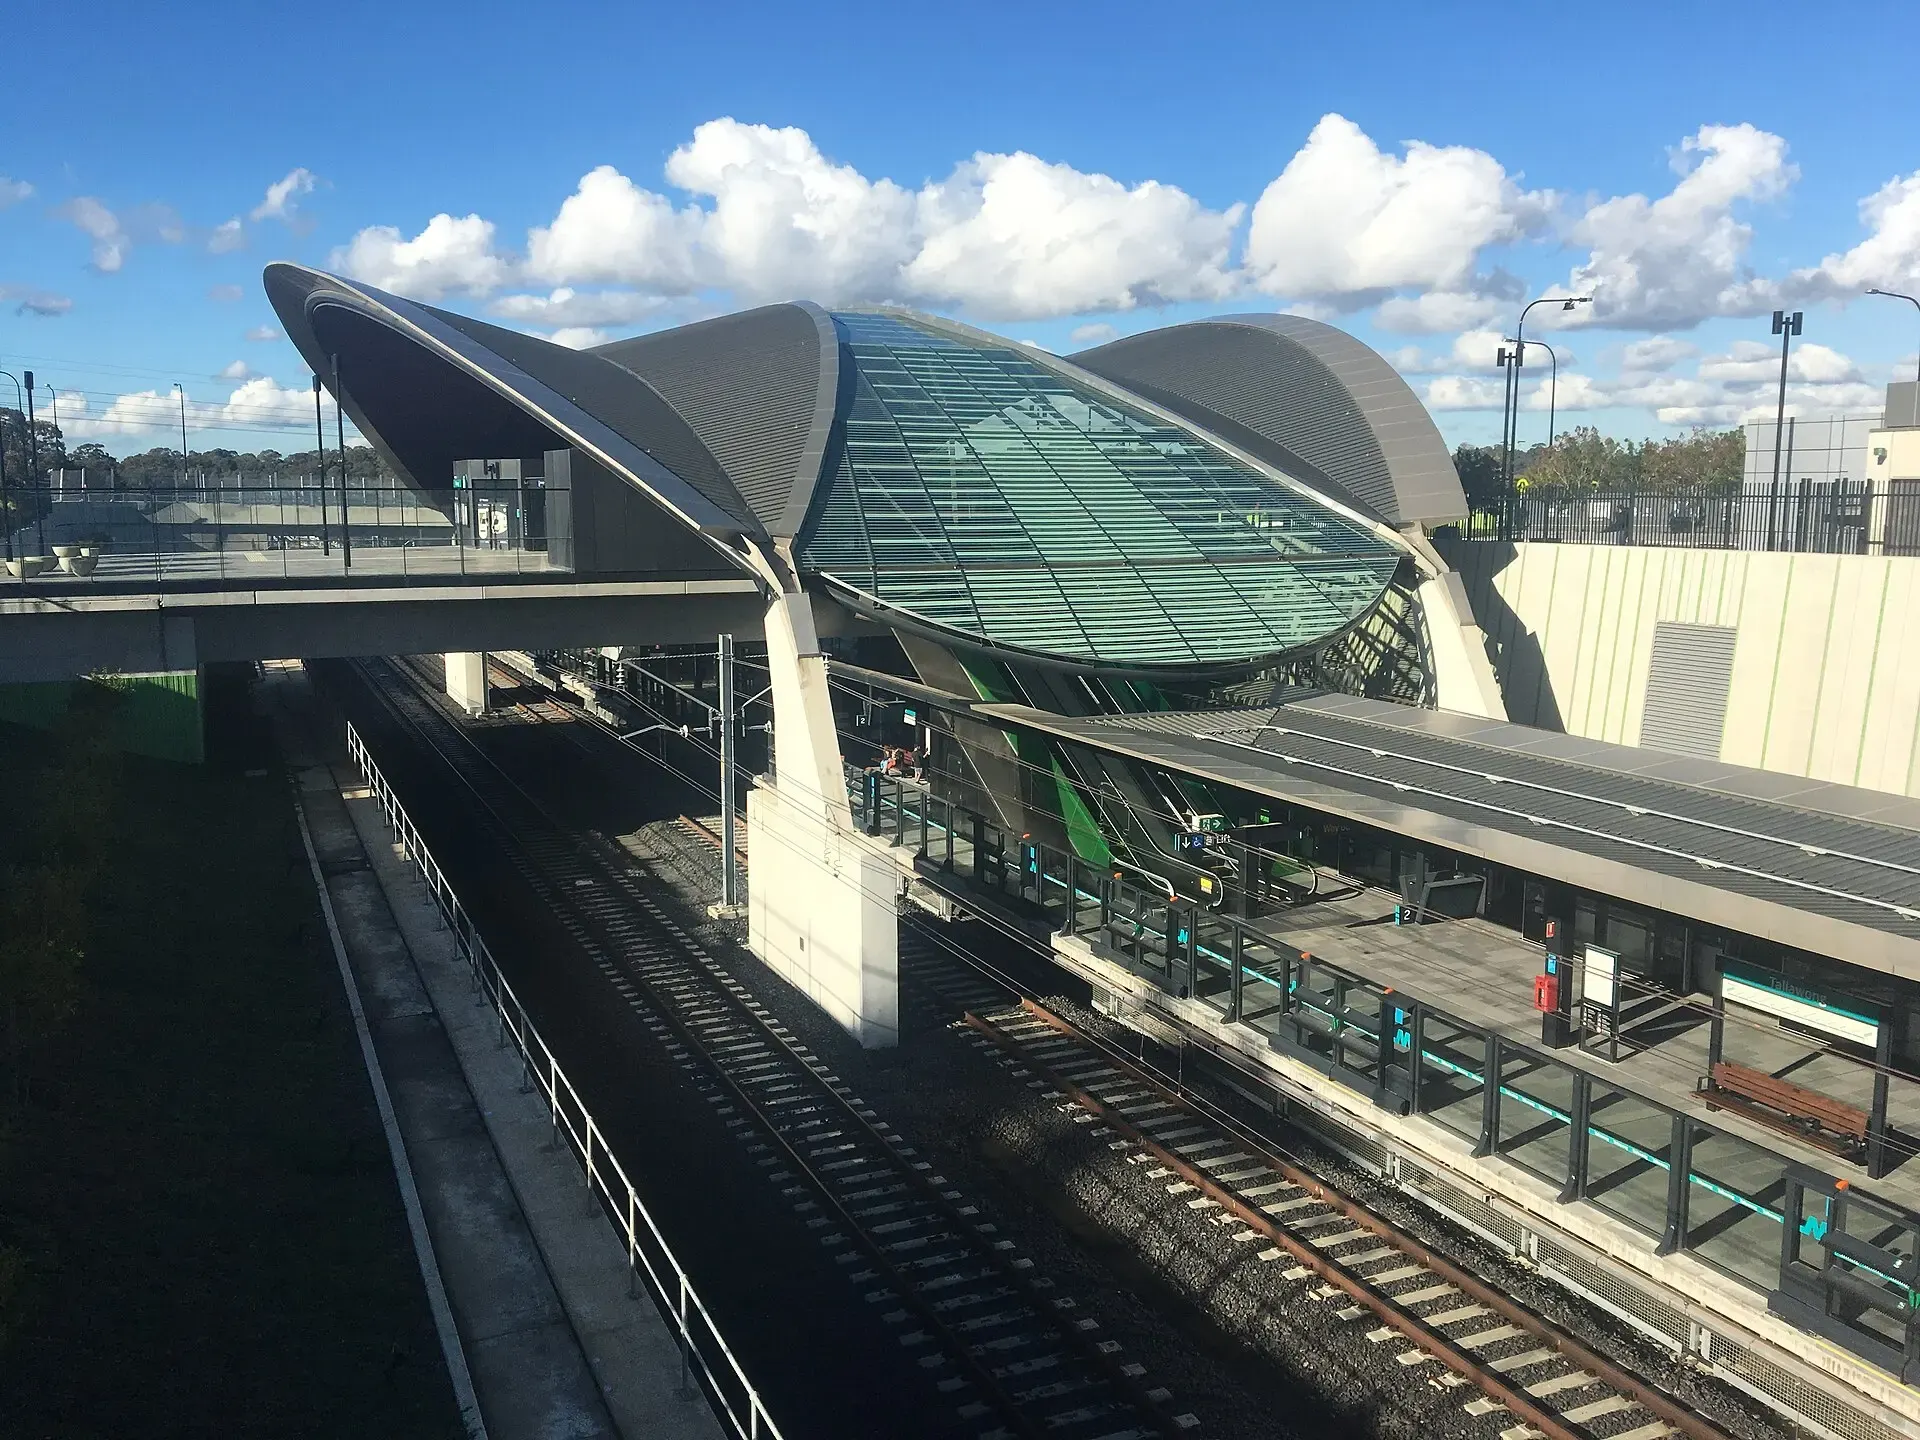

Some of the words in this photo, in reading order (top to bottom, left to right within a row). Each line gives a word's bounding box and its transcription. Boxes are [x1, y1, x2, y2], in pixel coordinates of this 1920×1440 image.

[860, 717, 866, 725] 2
[1216, 834, 1231, 844] Lift
[1403, 909, 1411, 921] 2
[1769, 976, 1827, 1008] Tallawong
